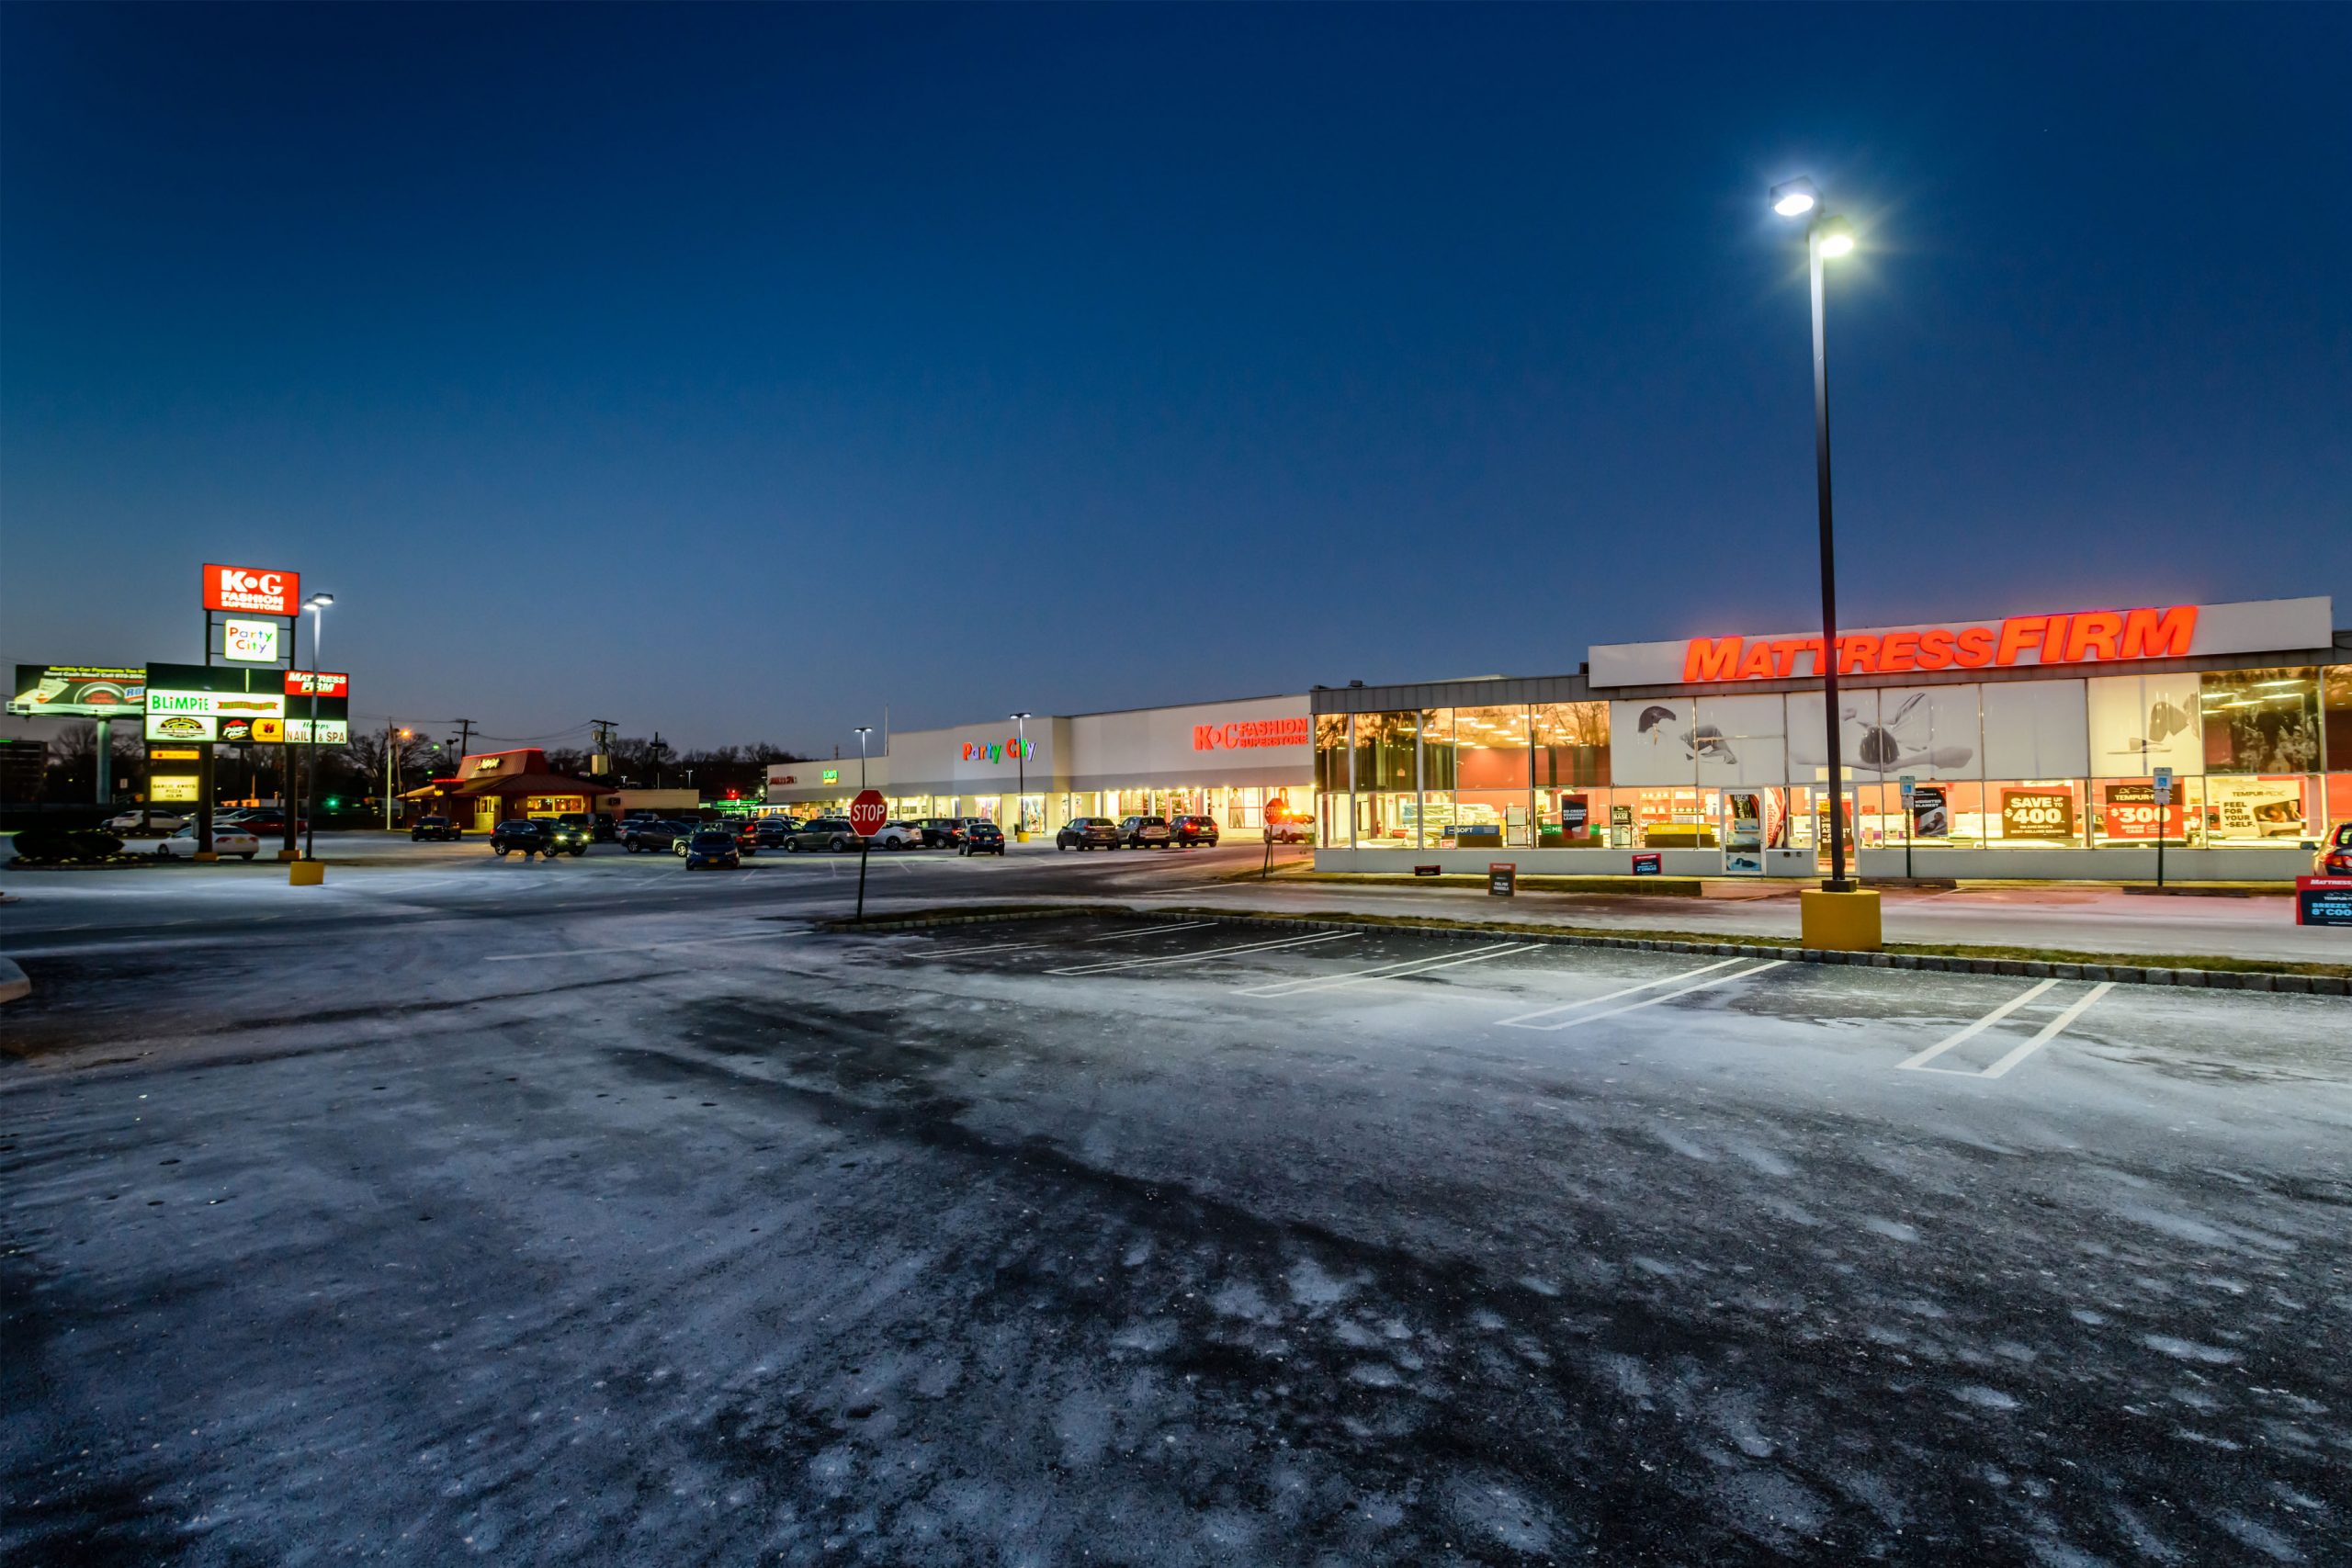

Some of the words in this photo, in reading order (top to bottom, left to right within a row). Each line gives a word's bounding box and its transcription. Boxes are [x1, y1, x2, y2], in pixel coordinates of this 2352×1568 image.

[221, 592, 283, 605] FASHION
[229, 626, 273, 642] Party
[235, 639, 266, 653] City
[288, 671, 346, 684] MATRESS
[1238, 717, 1308, 737] FASHION
[327, 731, 345, 742] SPA
[1238, 735, 1308, 749] SUPERSTORE
[962, 741, 1001, 764] Party
[1005, 737, 1036, 761] City
[2010, 796, 2052, 808] SAVE
[853, 804, 885, 821] STOP
[1266, 807, 1282, 817] STO
[2004, 807, 2062, 824] $400
[2110, 807, 2172, 823] $300
